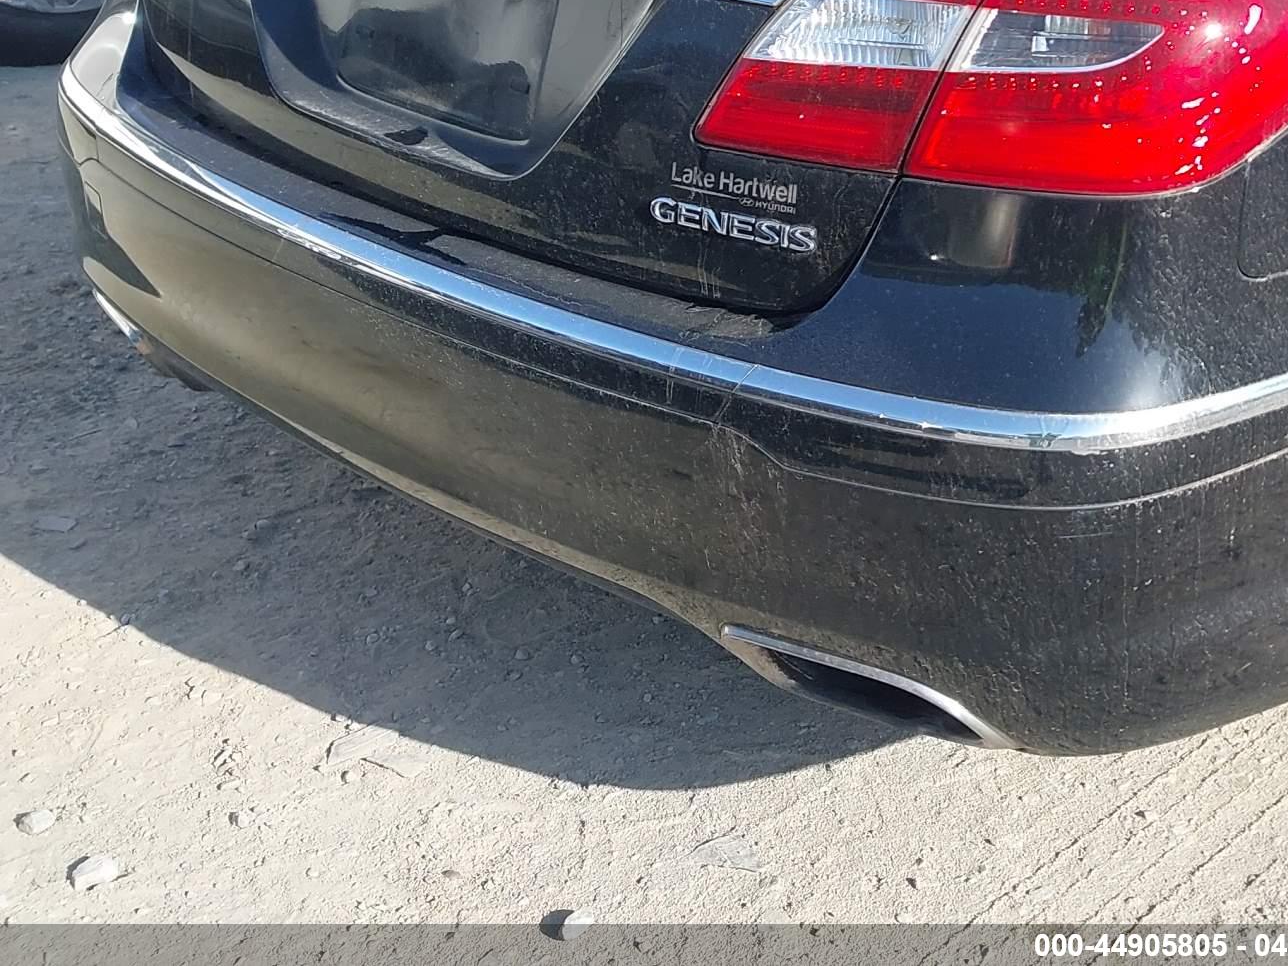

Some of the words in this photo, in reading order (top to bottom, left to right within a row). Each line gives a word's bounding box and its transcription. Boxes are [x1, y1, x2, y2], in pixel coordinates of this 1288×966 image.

[671, 161, 715, 189] Lake
[719, 170, 798, 204] Hartwell
[650, 196, 818, 253] GENESIS
[755, 201, 796, 214] HYUNDAI
